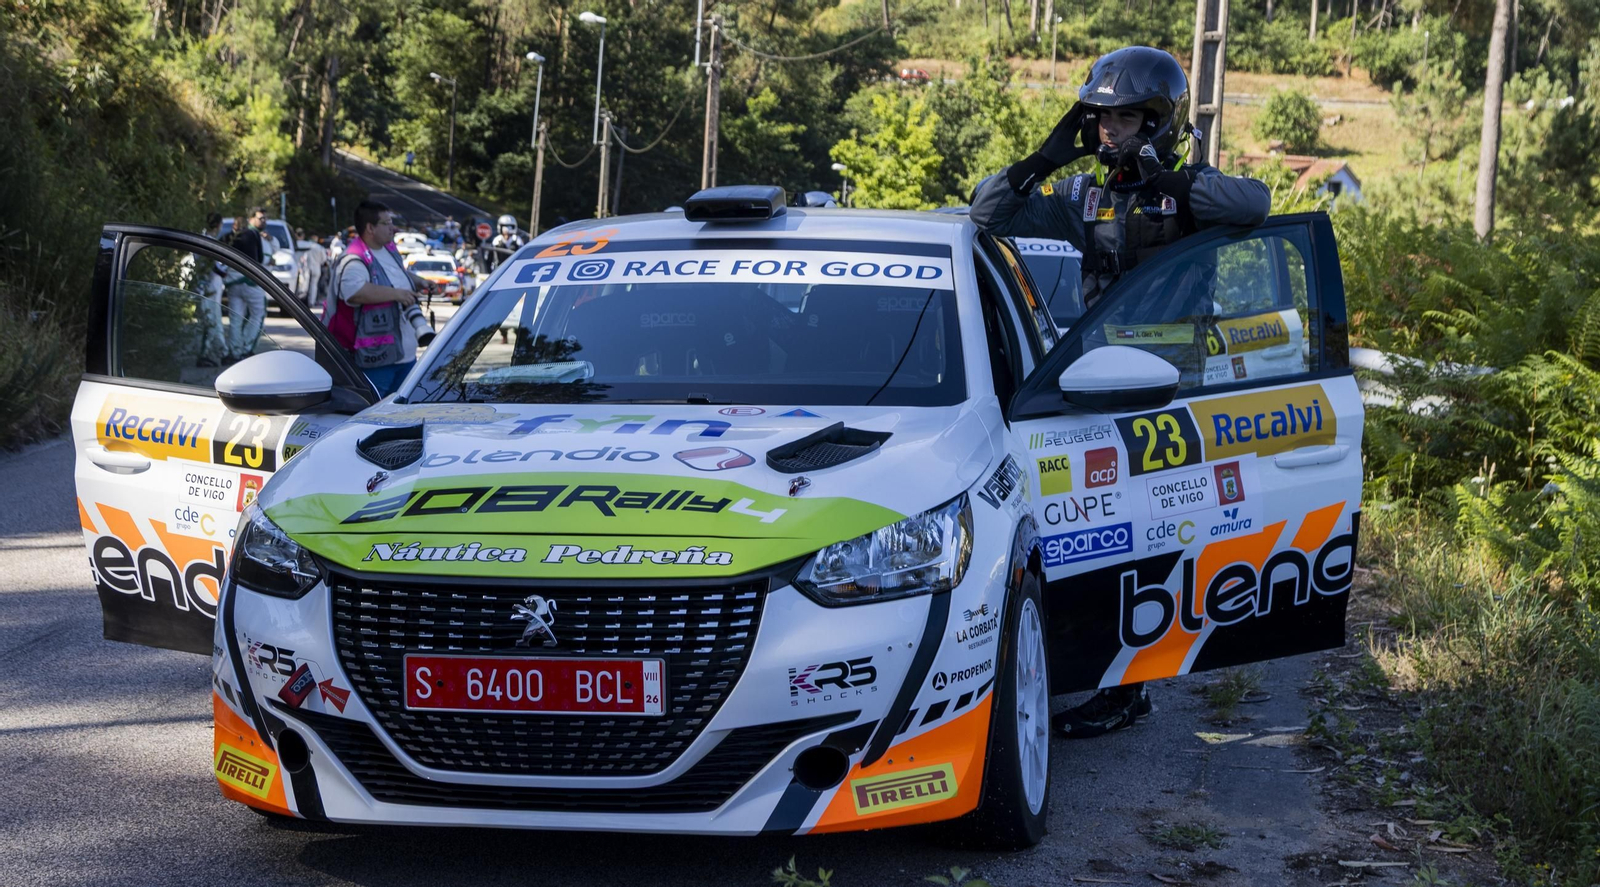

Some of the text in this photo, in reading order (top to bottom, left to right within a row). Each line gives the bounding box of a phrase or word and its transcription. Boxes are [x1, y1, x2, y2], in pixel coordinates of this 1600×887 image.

[1087, 190, 1098, 217] SIMPSON
[1017, 243, 1076, 253] GOOD
[622, 259, 944, 281] RACE FOR GOOD
[372, 313, 386, 324] 41
[640, 313, 697, 328] sparco
[1229, 319, 1283, 345] Recalvi
[105, 407, 206, 449] Recalvi
[1211, 399, 1323, 447] Recalvi
[223, 414, 271, 467] 23
[1044, 430, 1112, 448] PEUGEOT
[1132, 413, 1187, 472] 23
[420, 446, 660, 468] blendio
[1039, 457, 1069, 473] RACC
[185, 473, 232, 490] CONCELLO
[1090, 466, 1116, 484] acp
[188, 486, 225, 501] DE VIGO
[1151, 476, 1208, 498] CONCELLO
[1160, 491, 1205, 509] DE VIGO
[1210, 517, 1252, 536] amura
[362, 542, 733, 565] Náutica Pedreña
[1046, 526, 1129, 565] sparco
[1147, 541, 1166, 553] grupo
[89, 534, 228, 620] end
[956, 617, 998, 643] LA CORBATA
[249, 669, 287, 684] SHOCK
[644, 671, 658, 682] VIII
[950, 659, 992, 684] PROPENOR
[415, 666, 634, 704] S 6400 BCL
[790, 686, 878, 706] SHOCKS
[645, 694, 659, 704] 26
[216, 750, 270, 790] PIRELLI
[855, 769, 949, 809] PIRELLI
